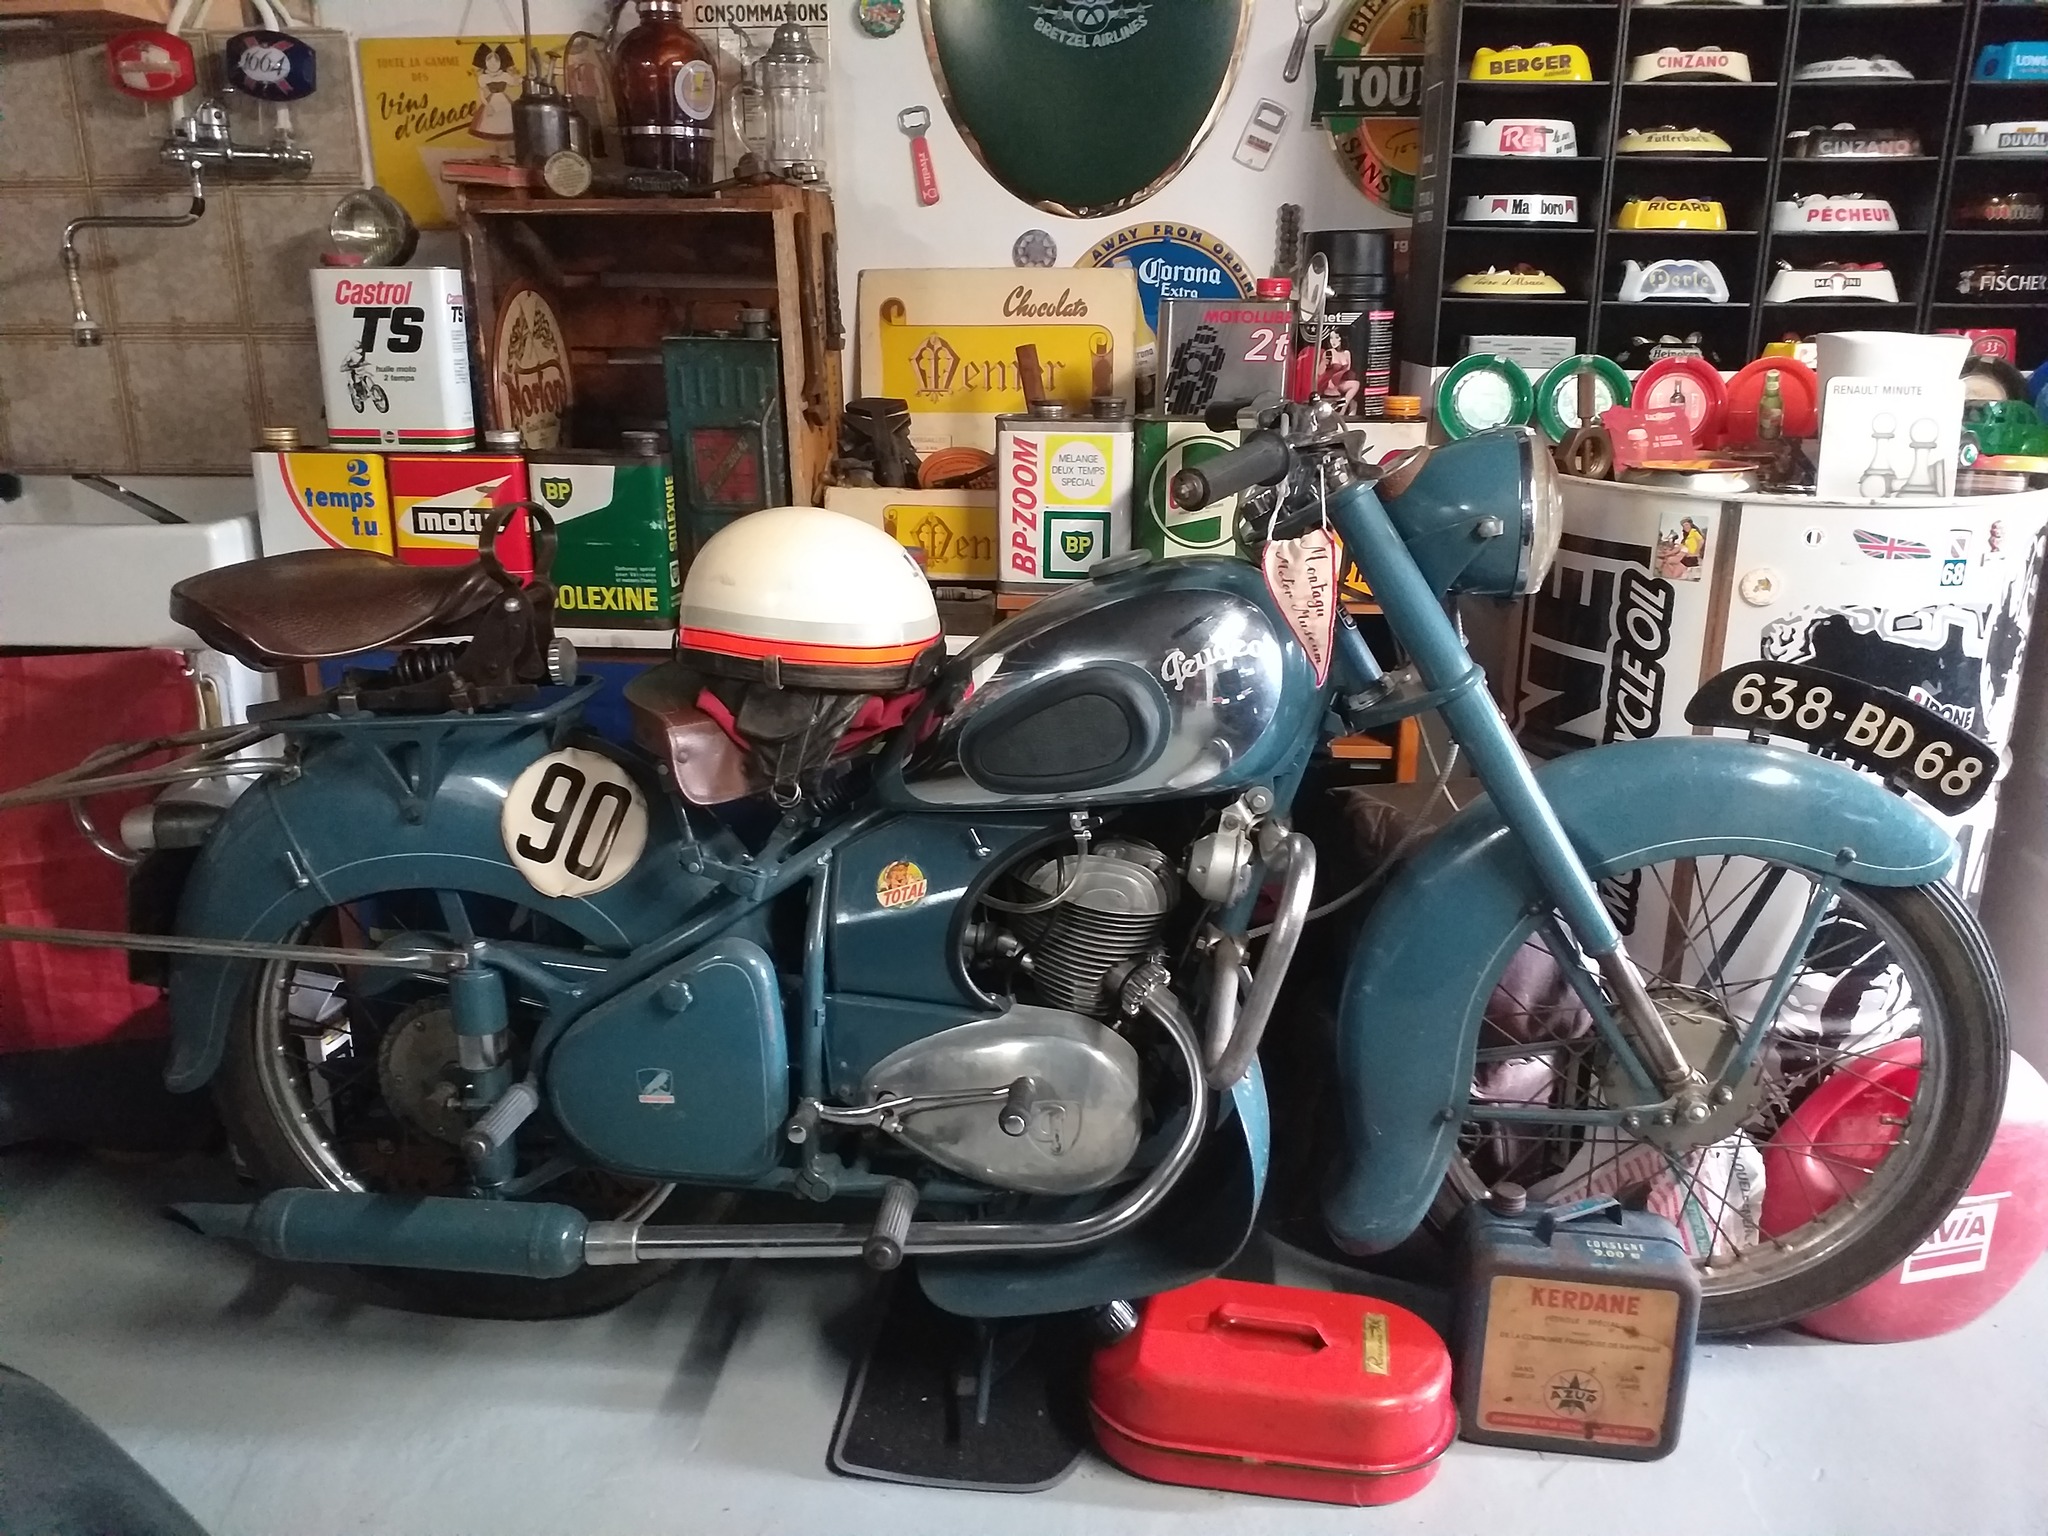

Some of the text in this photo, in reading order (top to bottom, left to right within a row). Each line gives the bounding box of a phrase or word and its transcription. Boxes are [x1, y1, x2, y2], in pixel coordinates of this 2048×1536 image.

[1033, 15, 1148, 48] BRETZEL AIRLINES
[242, 51, 285, 76] 1664
[410, 57, 420, 68] LA
[424, 56, 460, 67] GAMME
[1490, 54, 1572, 75] BERGER
[1657, 55, 1729, 69] CINZANO
[411, 72, 429, 82] DES
[377, 92, 429, 120] Vins
[1818, 139, 1912, 154] CINZANO
[1342, 137, 1392, 193] SANS
[1511, 199, 1564, 215] Maboro
[1647, 202, 1711, 212] RICARD
[1092, 228, 1138, 261] AWAY
[1153, 225, 1202, 242] FROM
[1138, 257, 1222, 287] Corona
[1650, 269, 1710, 293] Perle
[1979, 275, 2048, 291] FISCHER
[335, 280, 413, 305] Castrol
[1003, 285, 1089, 318] Chocolats
[1160, 282, 1199, 299] Extra
[451, 306, 463, 323] TS
[1203, 310, 1293, 324] MOTOLUBE
[352, 306, 426, 353] TS
[1243, 327, 1290, 363] 2t
[376, 365, 395, 373] huile
[502, 360, 567, 428] Norton
[1833, 385, 1922, 396] RENAULT MINUTE
[346, 459, 371, 487] 2
[1052, 465, 1105, 476] DEUX TEMPS
[304, 487, 375, 512] temps
[544, 482, 571, 501] BP
[664, 475, 679, 552] SOLEXINE
[1065, 535, 1092, 554] BP
[1300, 539, 1328, 617] Montagu
[1940, 562, 1965, 586] 68
[555, 584, 659, 612] OLEXINE
[1275, 551, 1322, 664] Motor Museum
[1626, 578, 1667, 651] OIL
[515, 762, 632, 881] 90
[883, 882, 924, 906] TOTAL
[1586, 1239, 1645, 1251] CONSIGNE
[1531, 1286, 1642, 1316] KERDANE
[1550, 1390, 1597, 1404] AZUR
